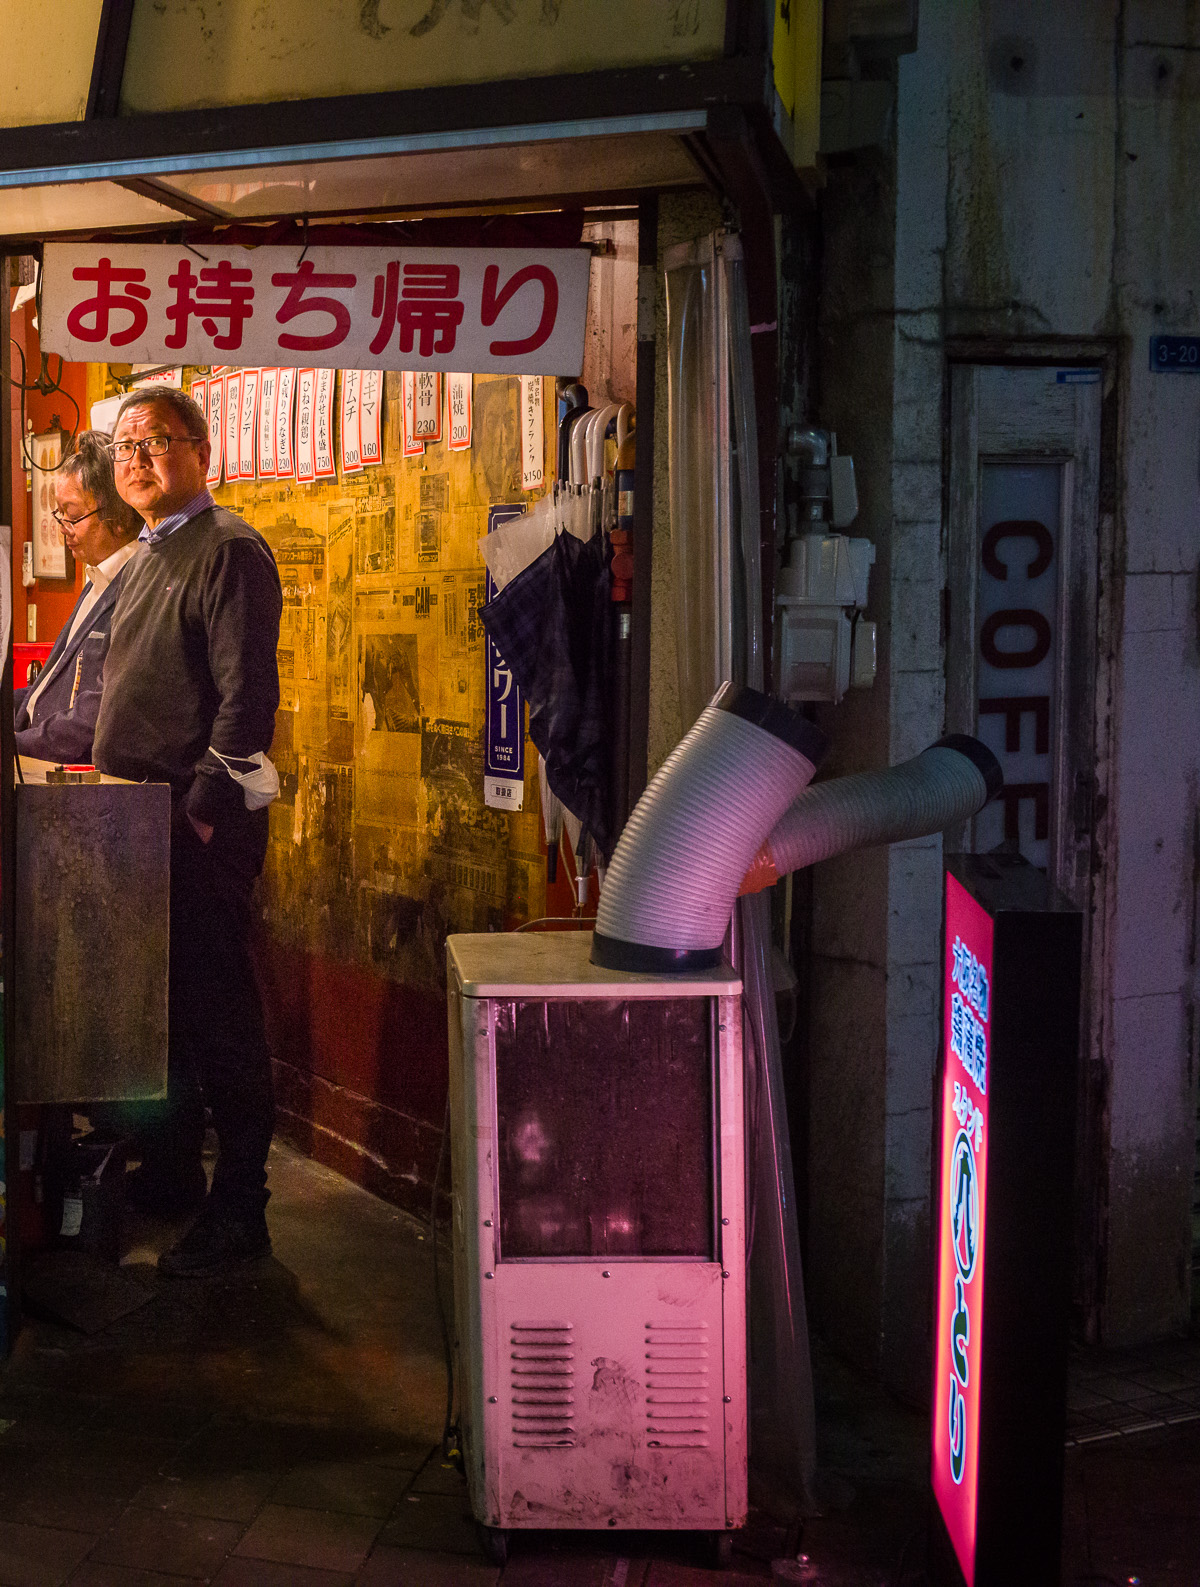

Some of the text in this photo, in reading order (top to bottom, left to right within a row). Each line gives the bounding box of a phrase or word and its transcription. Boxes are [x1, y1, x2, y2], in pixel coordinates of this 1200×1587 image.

[66, 257, 559, 357] お持ち帰り
[1158, 344, 1199, 363] 3-20
[345, 370, 358, 423] キムチ
[418, 372, 434, 407] 軟骨
[452, 383, 465, 416] 蒲焼
[416, 419, 435, 433] 230
[452, 425, 468, 440] 300
[363, 442, 377, 456] 160
[261, 458, 274, 470] 160
[278, 458, 290, 469] 230
[317, 456, 330, 468] 750
[345, 450, 359, 464] 300
[228, 461, 239, 473] 160
[241, 460, 252, 472] 160
[299, 462, 311, 474] 200
[494, 745, 513, 754] SINCE
[952, 1081, 984, 1153] スタンド
